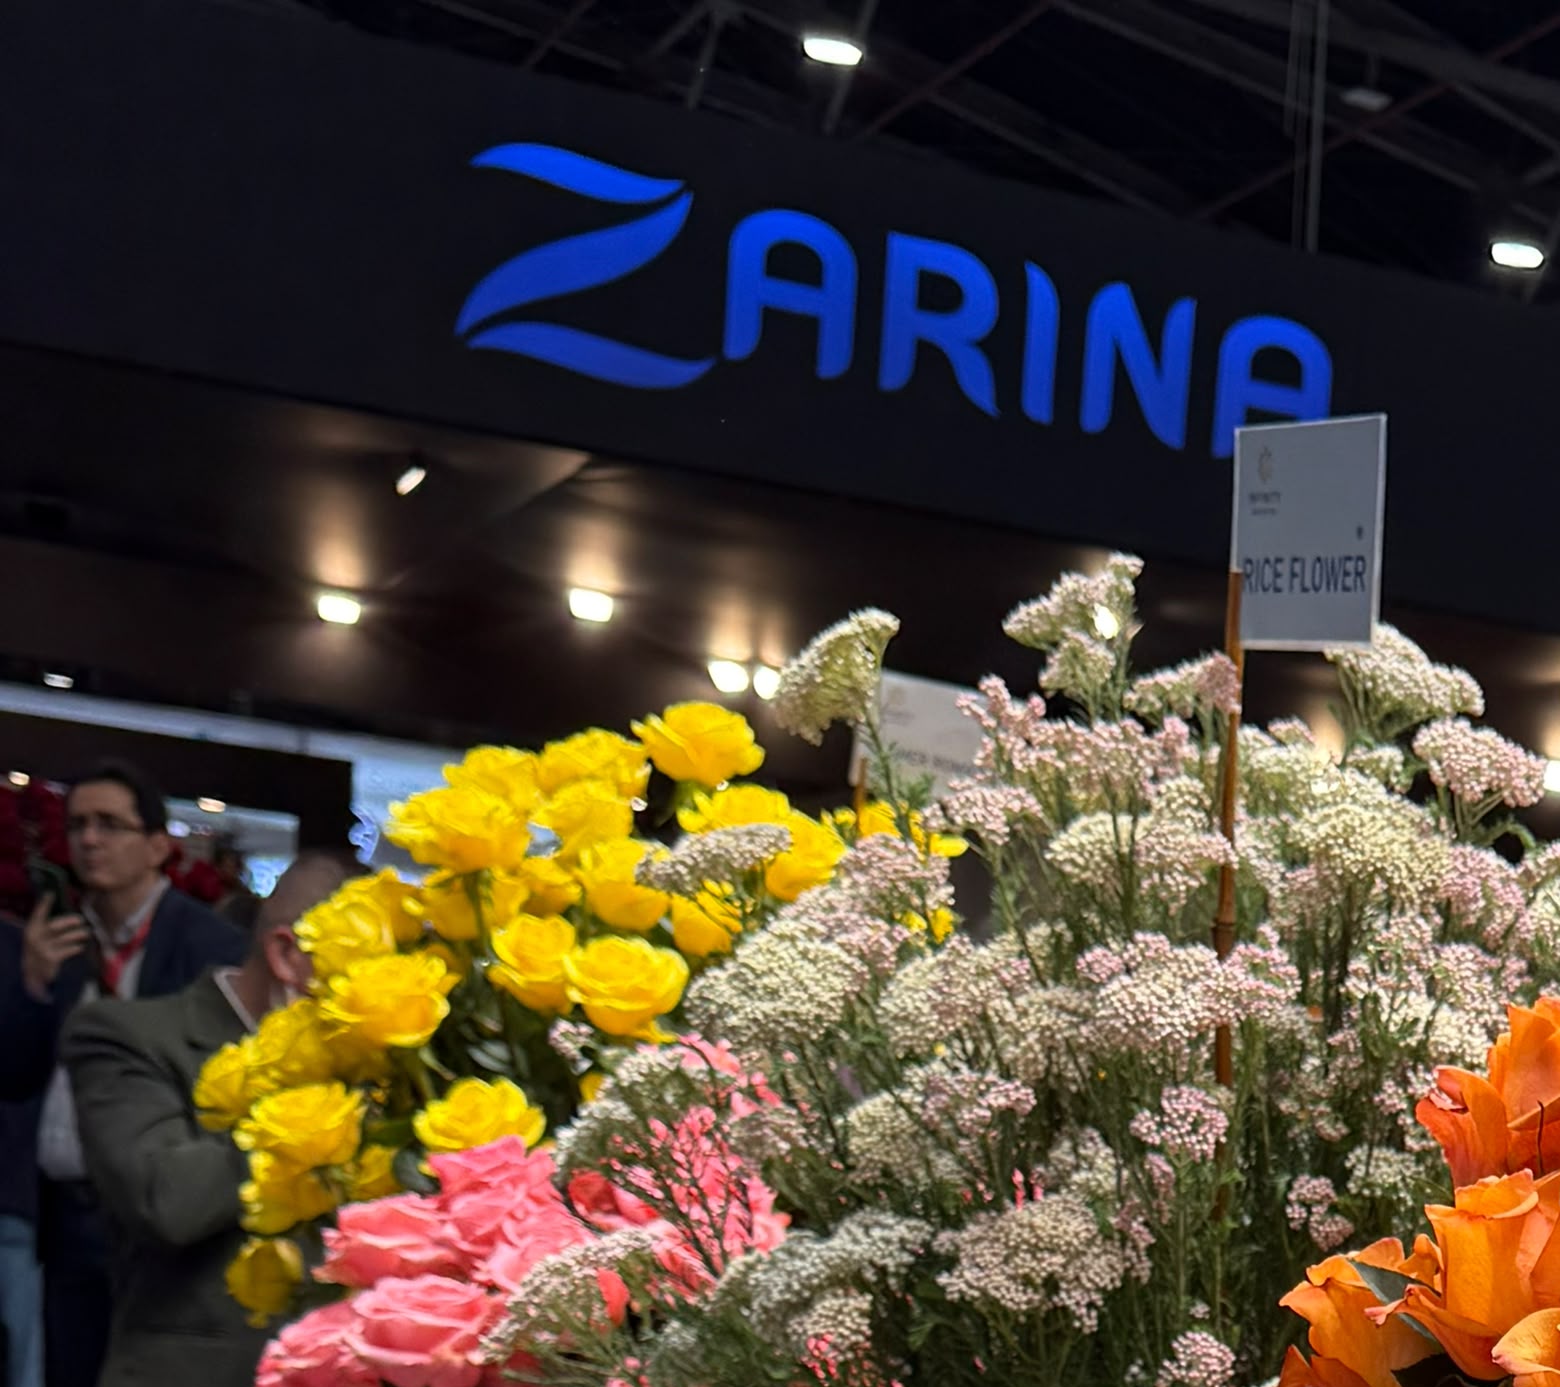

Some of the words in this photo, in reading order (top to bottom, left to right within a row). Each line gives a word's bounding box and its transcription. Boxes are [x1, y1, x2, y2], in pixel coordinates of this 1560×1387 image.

[457, 143, 1332, 457] ZARINA
[1244, 557, 1284, 593] RICE
[1289, 555, 1367, 593] FLOWER
